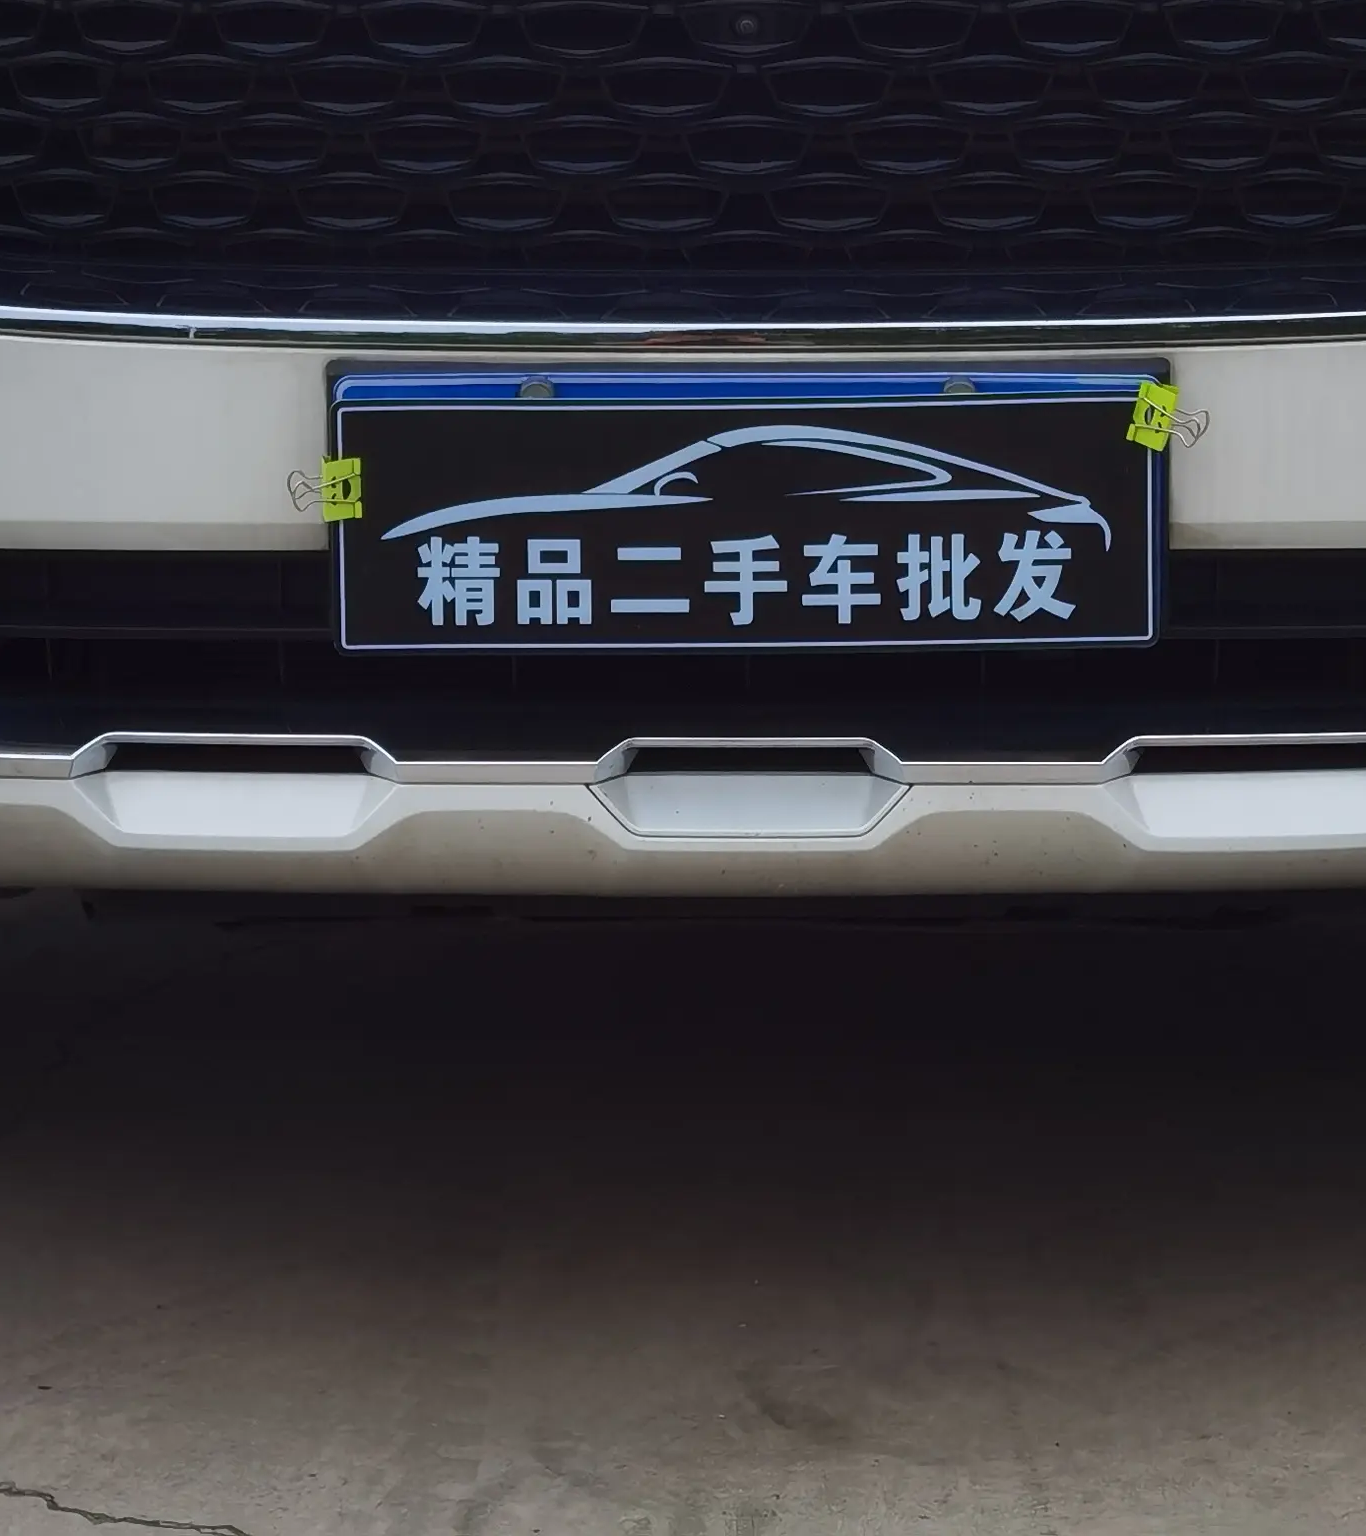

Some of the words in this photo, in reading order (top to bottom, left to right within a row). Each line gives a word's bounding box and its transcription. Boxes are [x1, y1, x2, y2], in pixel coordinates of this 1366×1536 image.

[416, 530, 1078, 626] 精品二手车批发
